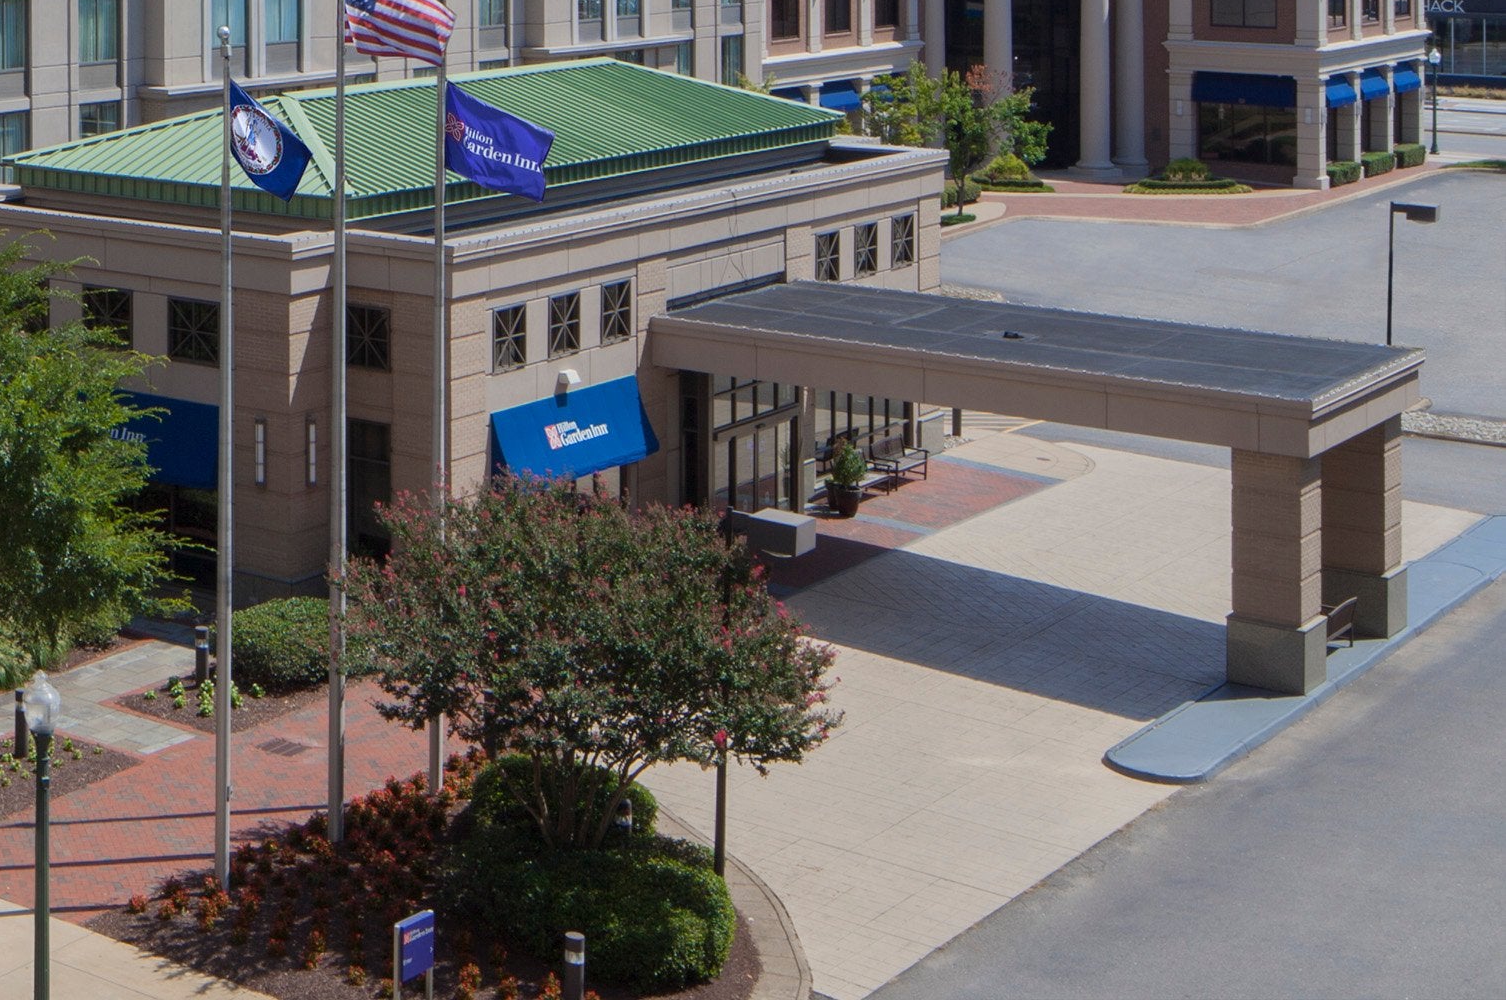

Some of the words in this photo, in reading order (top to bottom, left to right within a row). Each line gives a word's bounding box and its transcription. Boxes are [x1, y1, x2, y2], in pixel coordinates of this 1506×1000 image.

[463, 135, 512, 165] Garden
[514, 152, 541, 173] Inn
[560, 427, 593, 447] Garden
[590, 423, 609, 438] Inn
